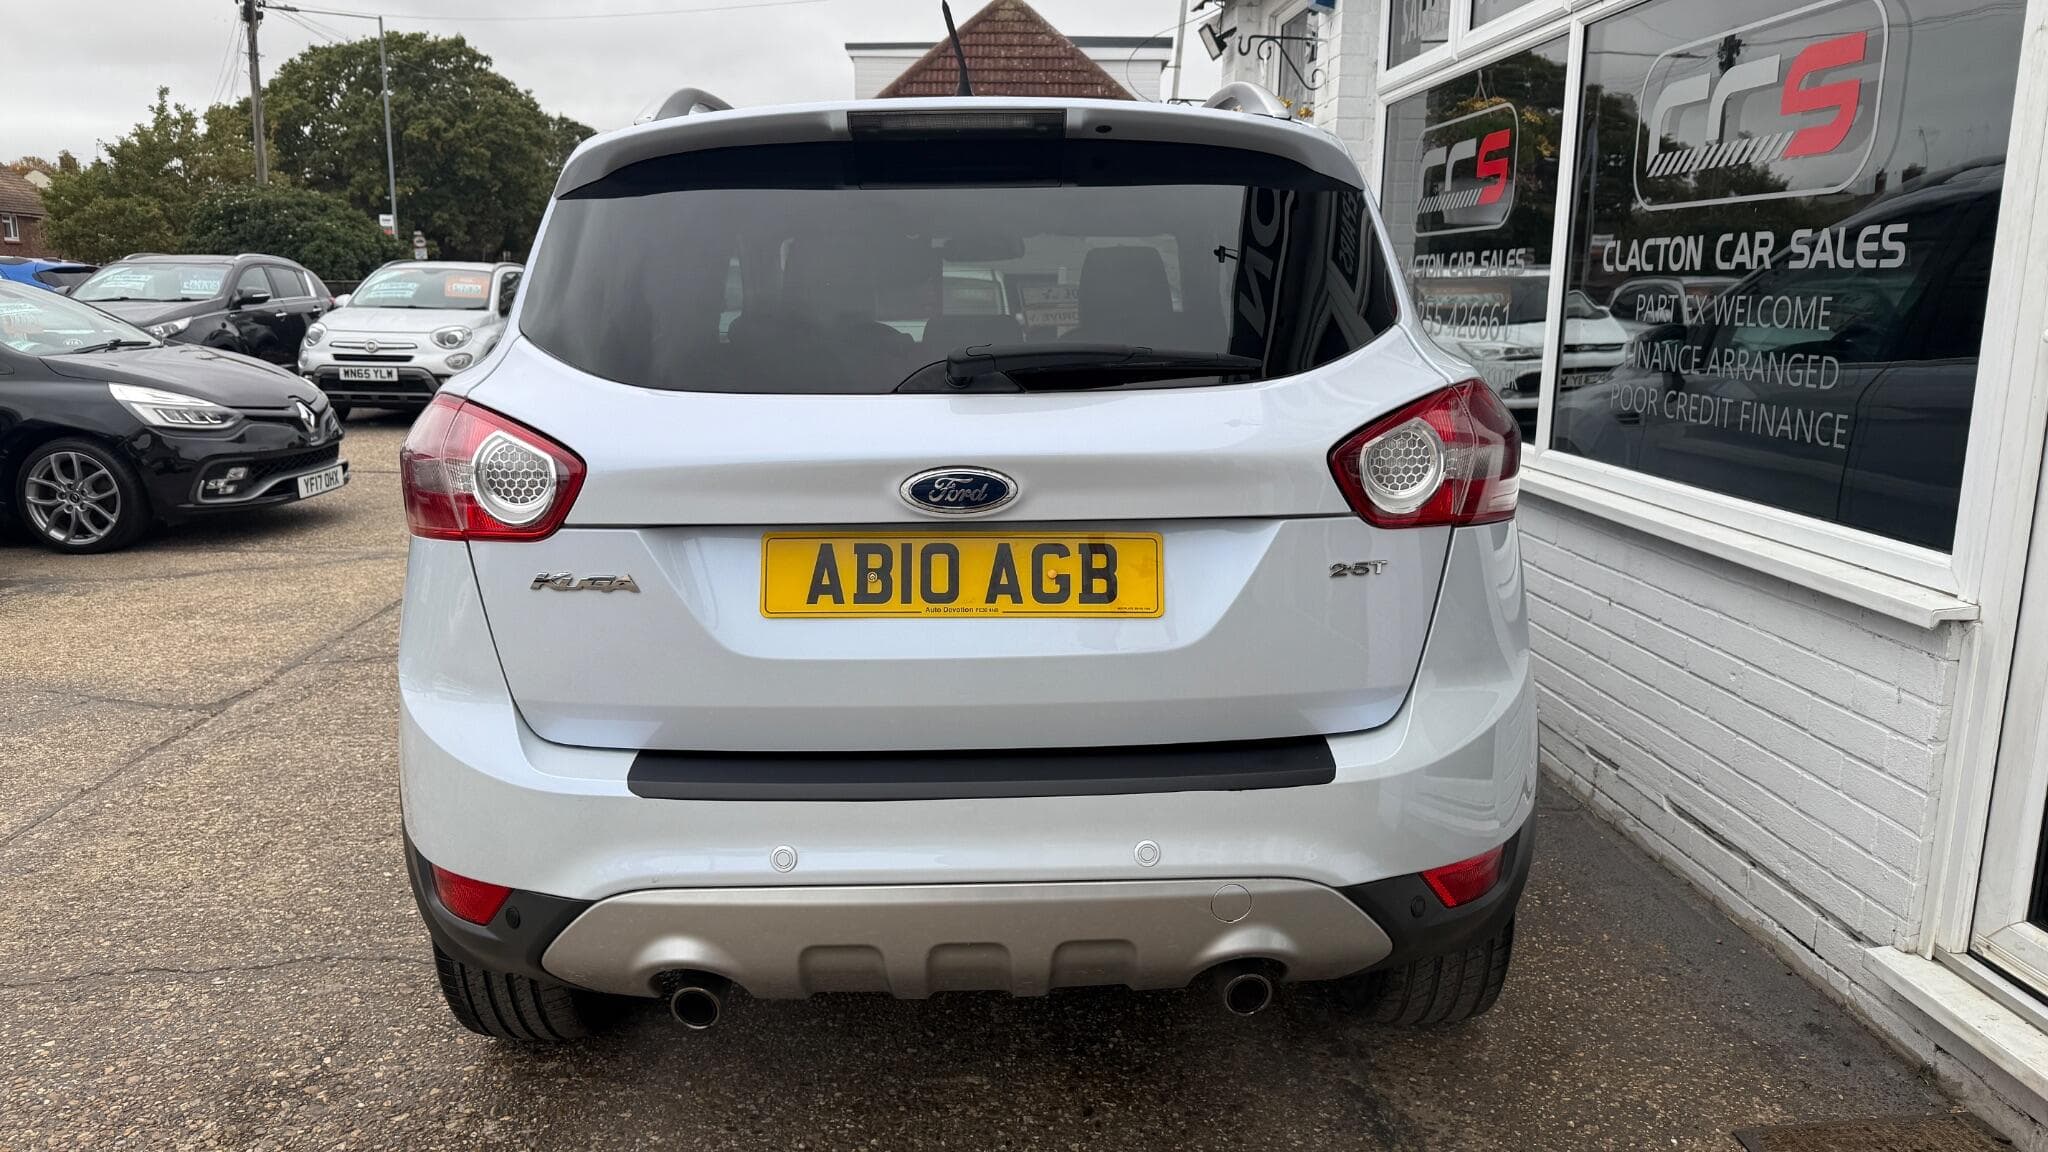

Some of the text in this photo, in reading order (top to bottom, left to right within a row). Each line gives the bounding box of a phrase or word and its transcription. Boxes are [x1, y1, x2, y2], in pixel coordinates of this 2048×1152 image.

[1398, 248, 1526, 278] ACTON CAR SALES
[1602, 223, 1909, 272] CLACTON CAR SALES
[1418, 301, 1510, 342] 255 426661
[1635, 294, 1833, 331] PART EX WELCOME
[343, 368, 393, 379] WN65 YLW
[1625, 338, 1839, 390] FINANCE ARRANGED
[1610, 383, 1849, 450] POOR CREDIT FINANCE
[304, 474, 323, 494] YF17
[928, 477, 989, 502] Ford
[806, 543, 1118, 605] AB10 AGB
